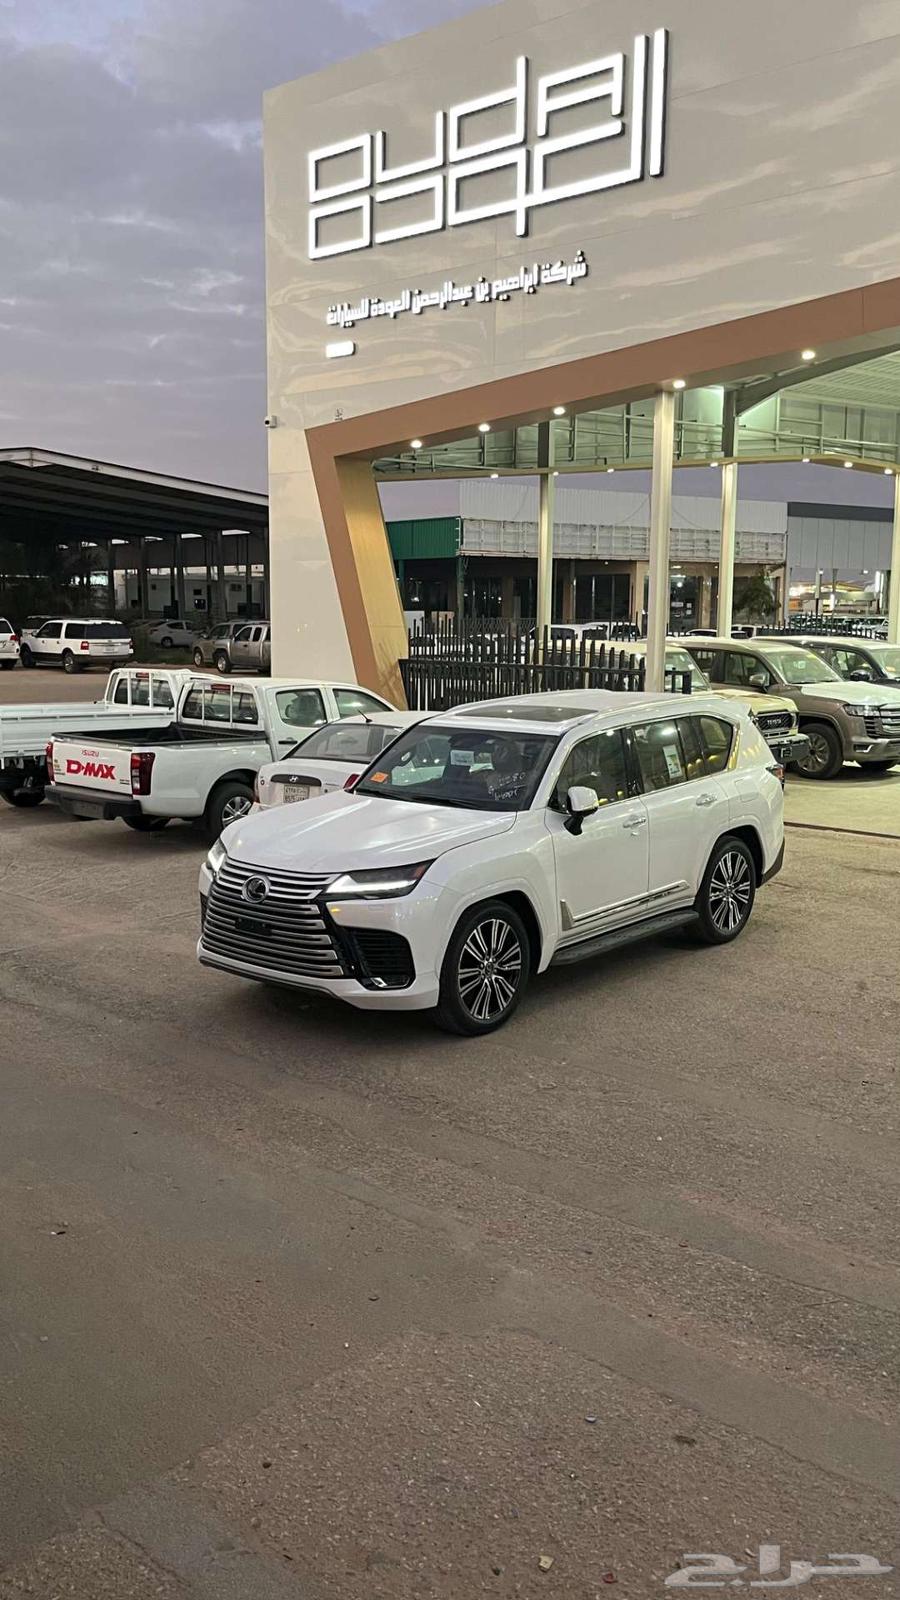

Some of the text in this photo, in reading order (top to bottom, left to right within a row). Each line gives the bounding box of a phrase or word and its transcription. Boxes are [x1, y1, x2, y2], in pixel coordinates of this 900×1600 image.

[541, 249, 587, 285] شركة
[475, 276, 490, 302] بن
[326, 297, 370, 328] للسيارات
[370, 289, 411, 319] العودة
[81, 749, 100, 758] ISUZU
[66, 759, 116, 780] D-MAX
